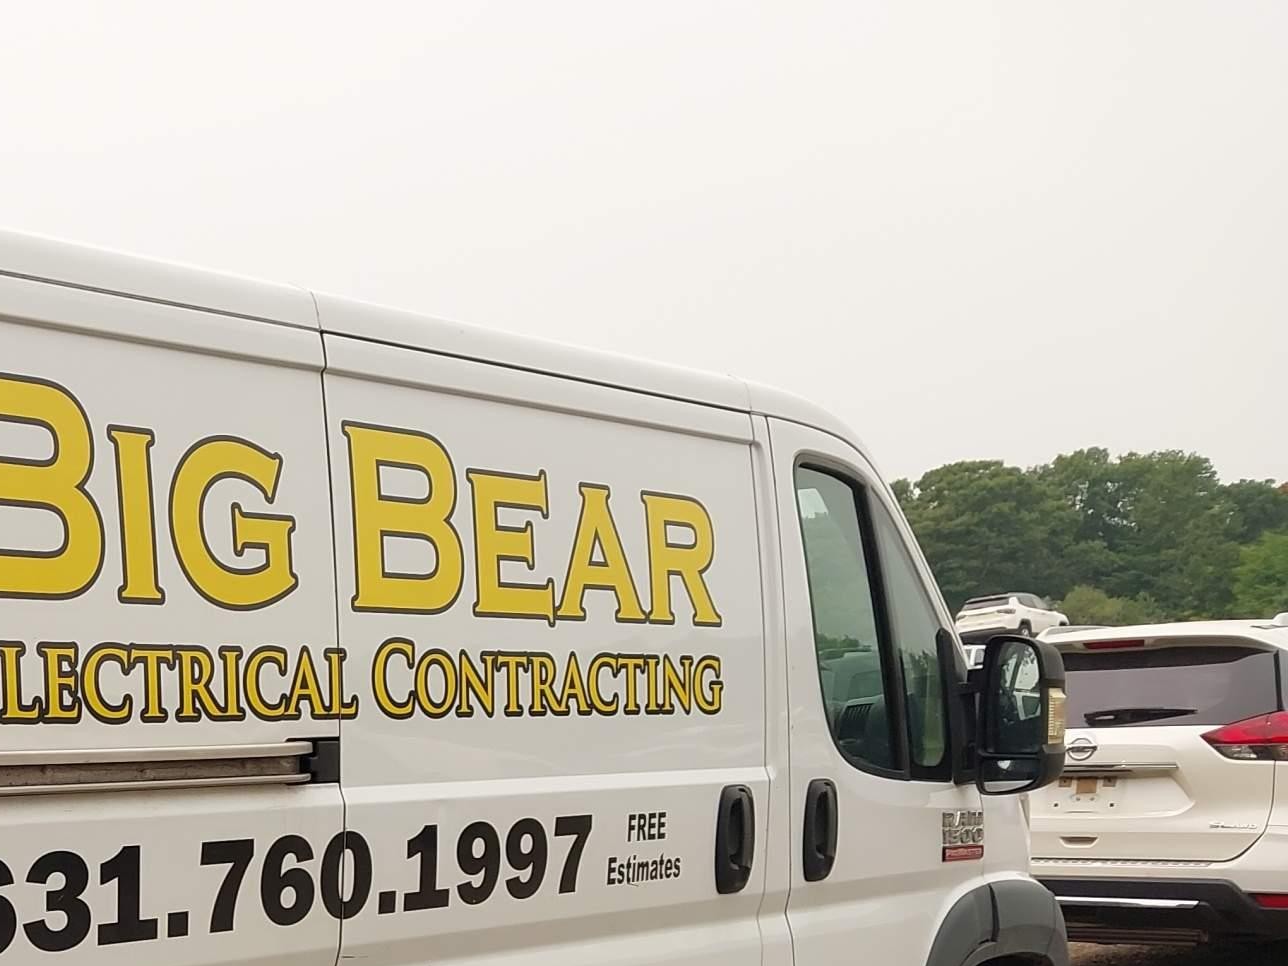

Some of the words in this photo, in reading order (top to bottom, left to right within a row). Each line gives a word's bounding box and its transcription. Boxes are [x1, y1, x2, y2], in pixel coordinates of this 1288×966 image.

[342, 421, 723, 627] BEAR
[372, 637, 723, 721] CONTRACTING
[627, 811, 667, 842] FREE
[606, 852, 681, 886] Estimates
